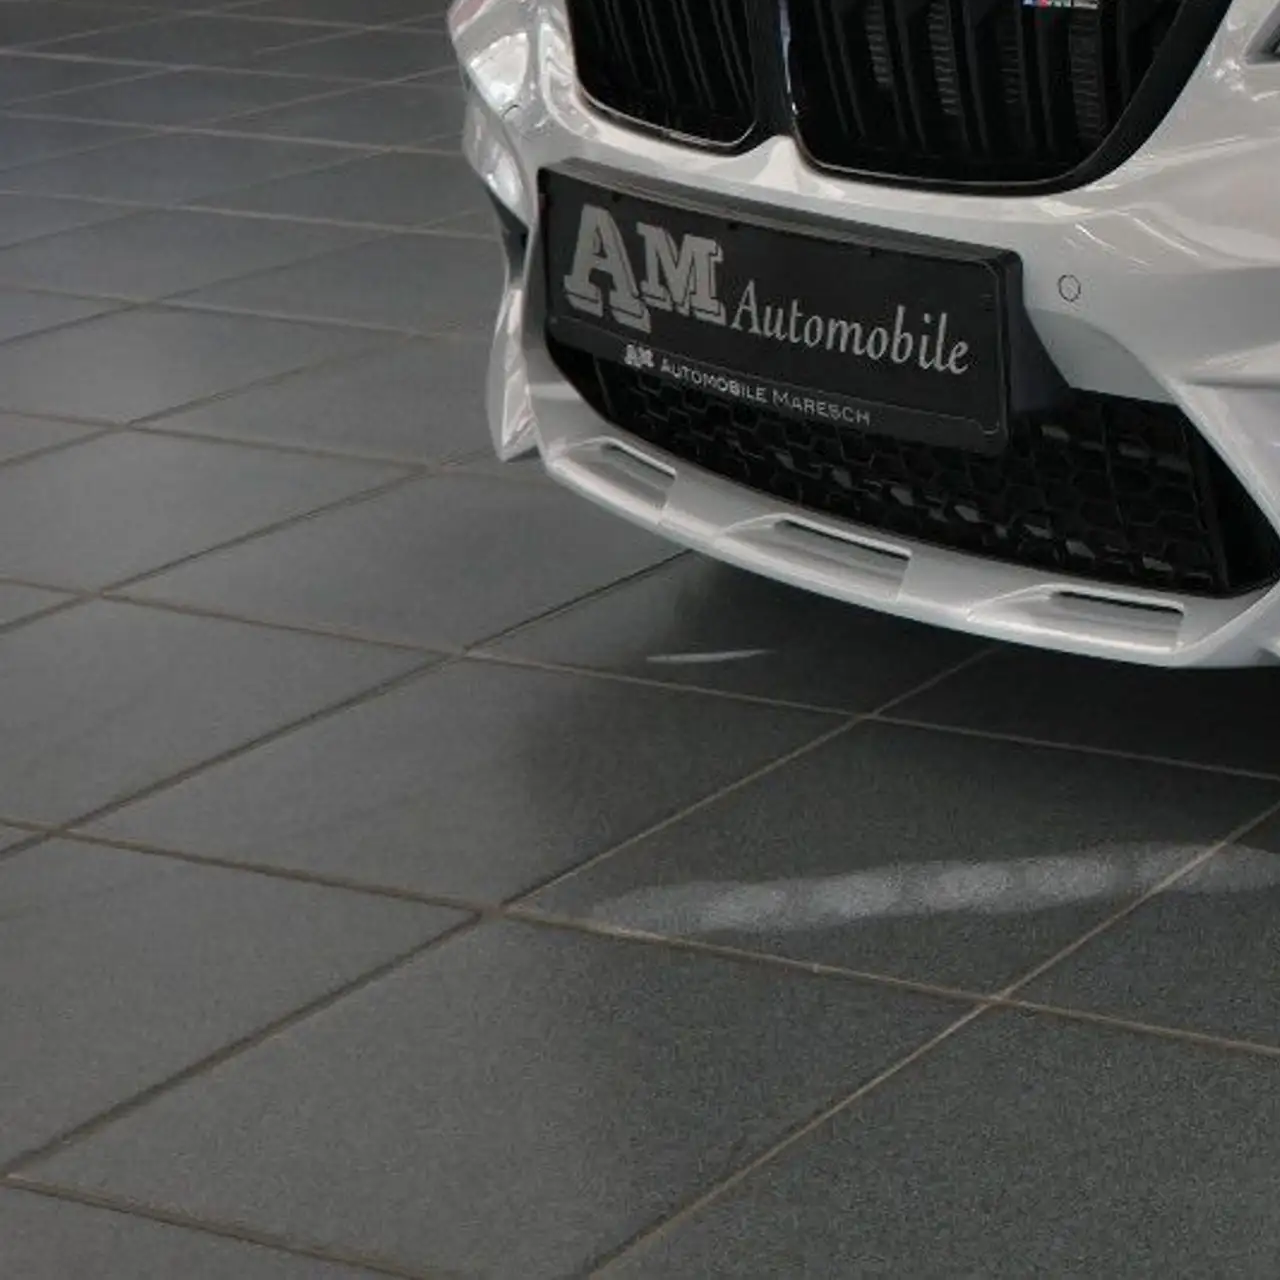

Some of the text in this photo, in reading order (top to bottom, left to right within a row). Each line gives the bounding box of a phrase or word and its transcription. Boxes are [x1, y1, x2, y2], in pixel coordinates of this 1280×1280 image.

[563, 203, 971, 375] AM Automobile
[660, 358, 768, 404] AUTOMOBILE
[772, 389, 871, 425] MARESCH
